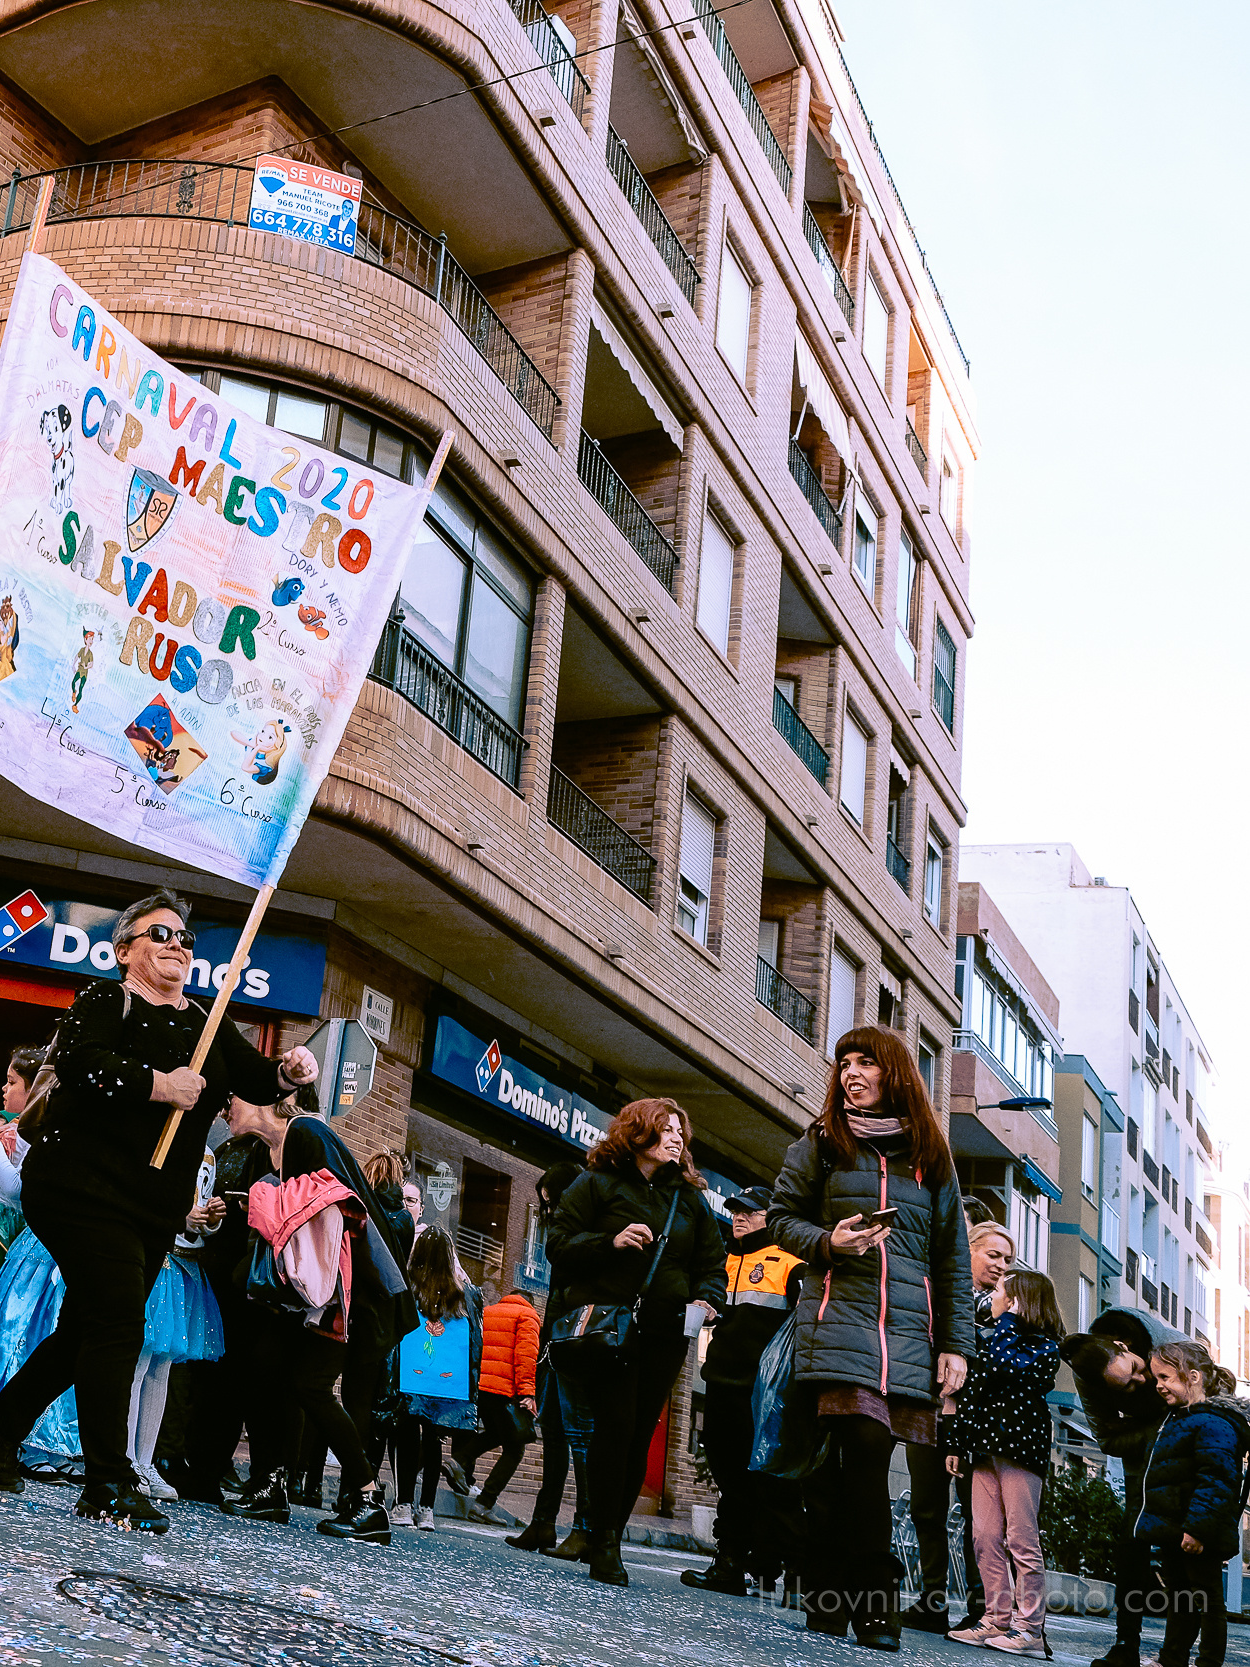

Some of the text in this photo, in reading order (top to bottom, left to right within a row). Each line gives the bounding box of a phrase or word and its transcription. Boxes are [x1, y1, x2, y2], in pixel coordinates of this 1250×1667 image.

[282, 190, 340, 211] MANUEL RICOTE
[290, 167, 361, 198] SE VENDE
[303, 189, 323, 198] TEAM
[277, 199, 294, 208] 966
[295, 203, 312, 212] 700
[314, 208, 329, 217] 368
[252, 209, 287, 228] 664
[293, 217, 323, 237] 778
[327, 227, 354, 248] 316
[277, 227, 330, 246] REMAX VISTA
[26, 379, 80, 409] DALMATAS
[49, 284, 242, 470] CARNAVAL
[269, 447, 376, 520] 2020
[81, 386, 143, 462] CEP
[168, 445, 372, 574] MAESTRO
[57, 510, 260, 661] SALVADOR
[289, 553, 318, 578] DORY
[326, 592, 348, 627] NEMO
[119, 616, 234, 704] RUSO
[498, 1068, 569, 1134] Domino's
